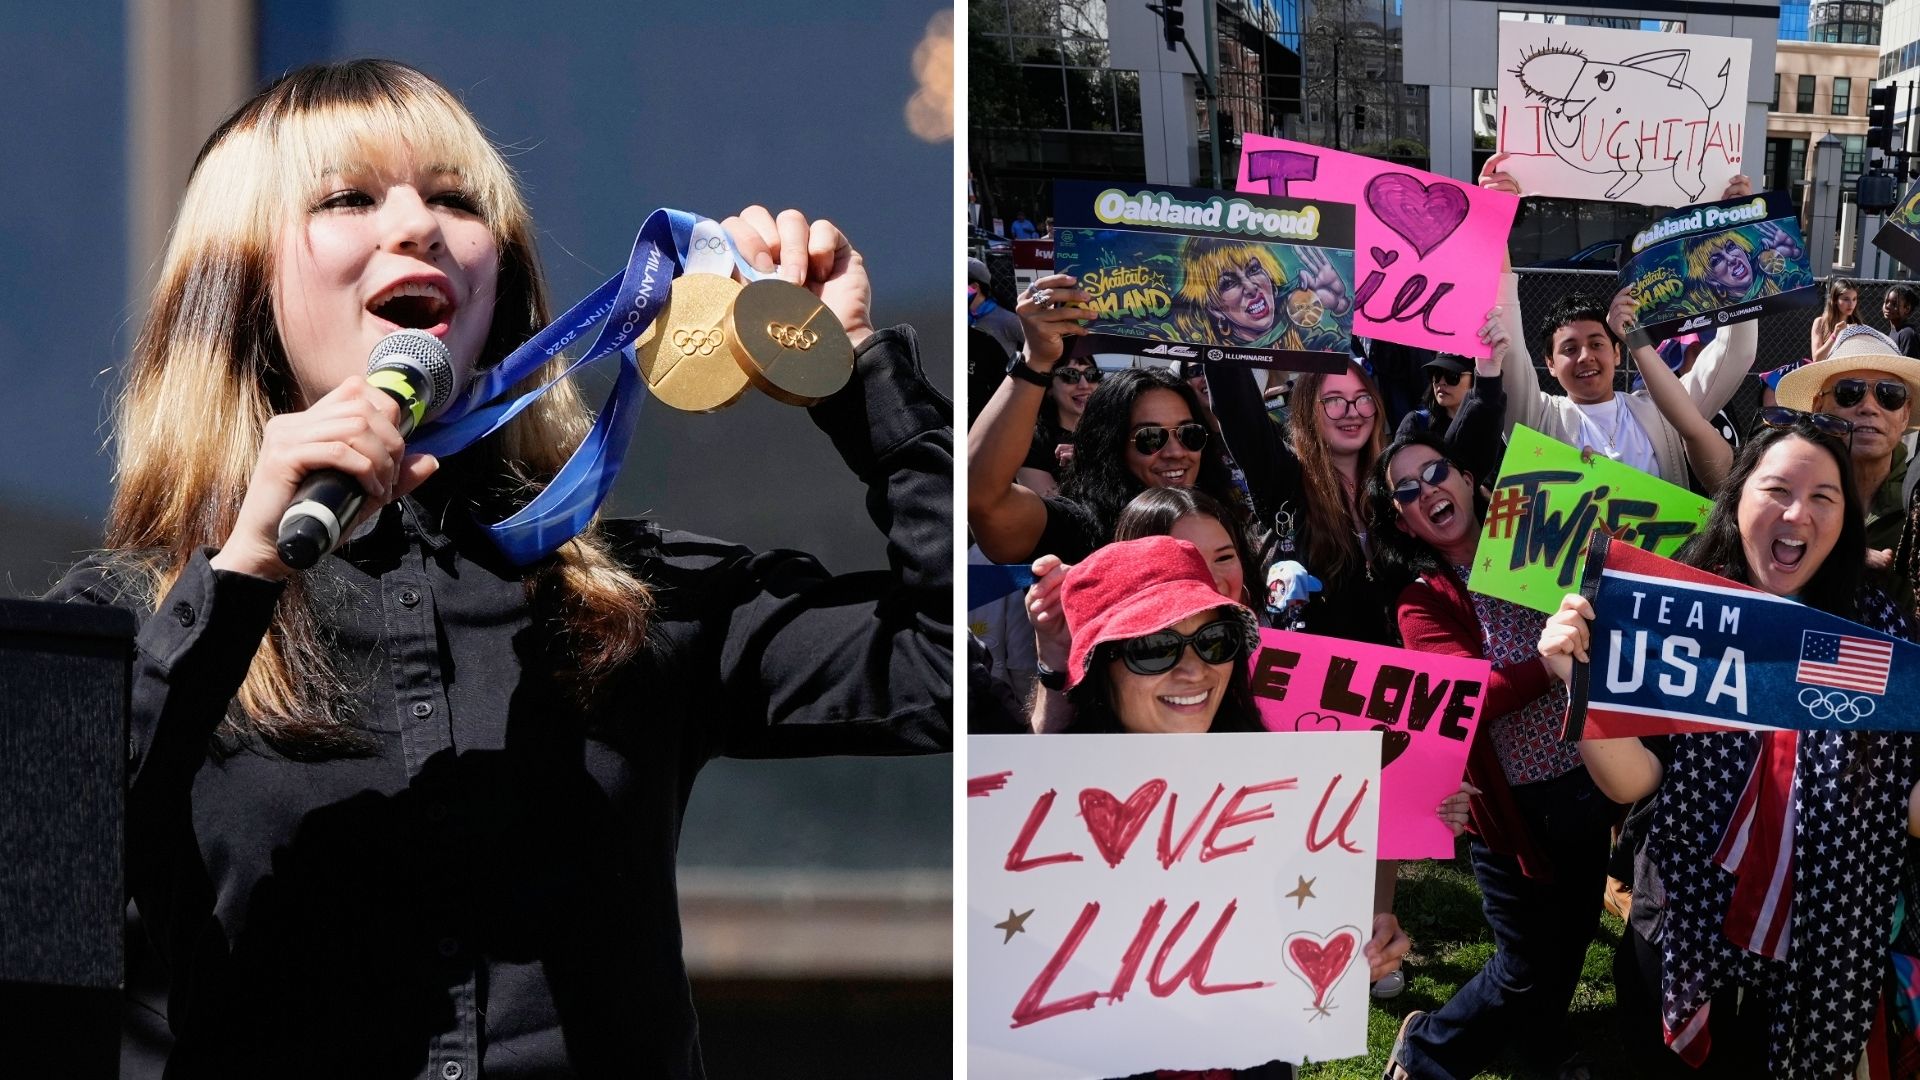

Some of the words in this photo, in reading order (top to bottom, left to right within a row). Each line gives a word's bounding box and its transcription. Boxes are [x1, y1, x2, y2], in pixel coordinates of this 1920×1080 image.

[1101, 192, 1222, 227] Oakland
[1226, 203, 1317, 236] Proud
[1633, 211, 1703, 249] Oakland
[1705, 202, 1765, 228] Proud
[635, 240, 661, 309] MILANO
[546, 330, 577, 356] 2026
[1225, 353, 1273, 362] ILLUMINARIES
[1632, 591, 1741, 635] TEAM
[1320, 655, 1482, 742] LOVE
[1606, 629, 1748, 716] USA
[1305, 773, 1369, 855] U
[1010, 896, 1276, 1029] LIU
